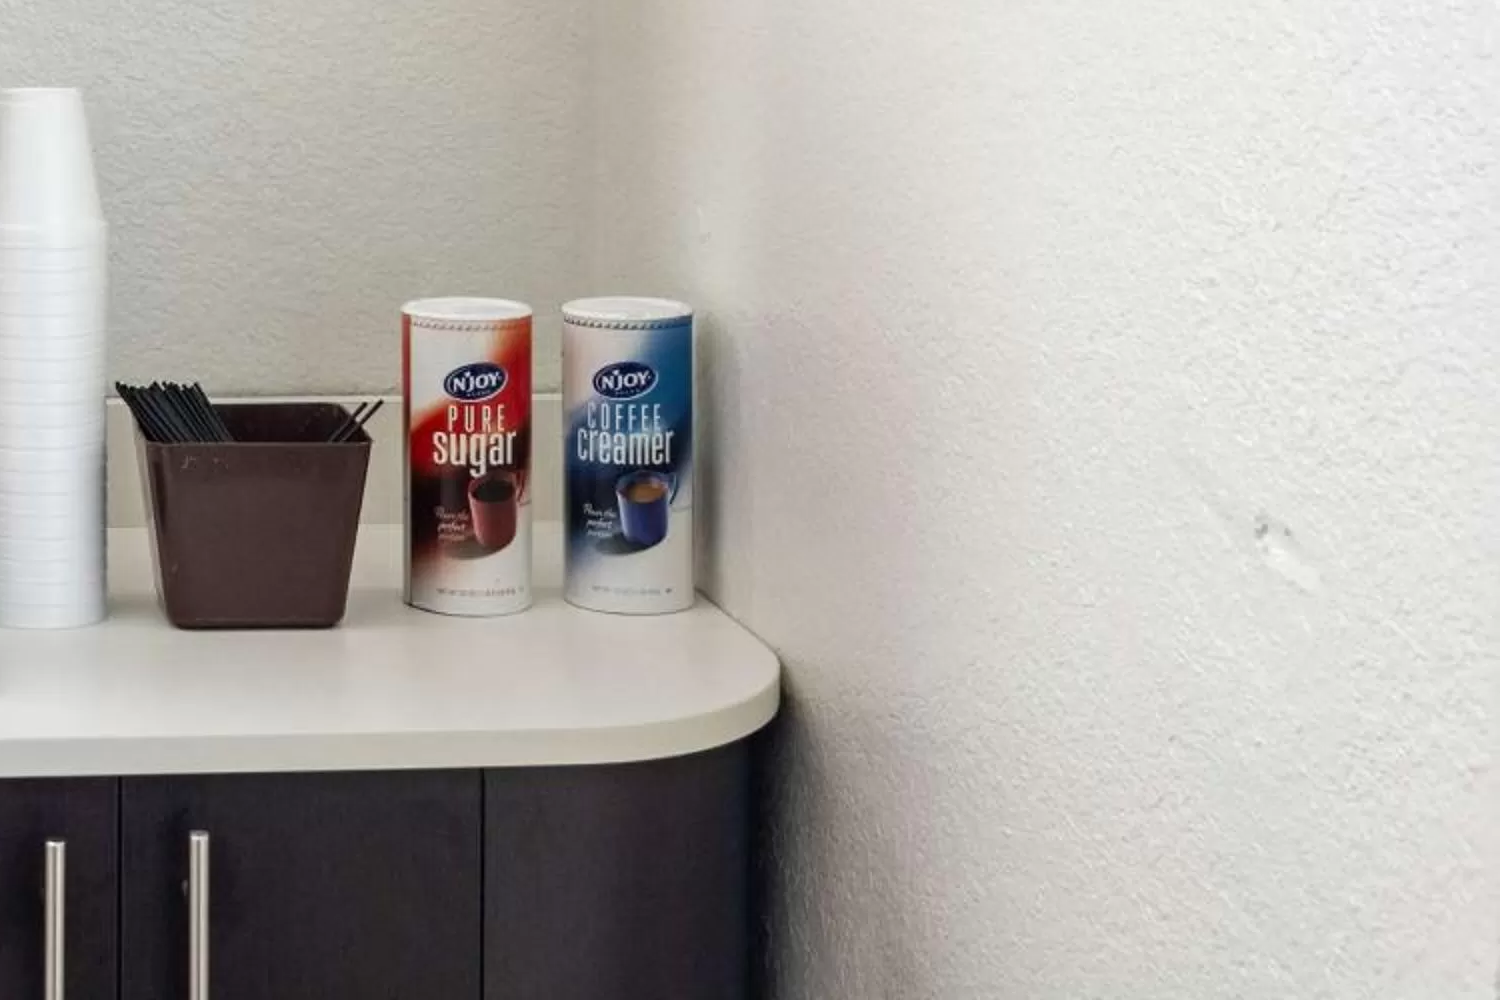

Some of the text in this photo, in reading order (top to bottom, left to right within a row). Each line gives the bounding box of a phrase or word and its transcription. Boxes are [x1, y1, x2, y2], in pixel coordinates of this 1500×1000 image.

[447, 404, 505, 432] PURE
[587, 404, 661, 431] COFFEE
[432, 430, 517, 478] sugar
[577, 430, 675, 466] creamer
